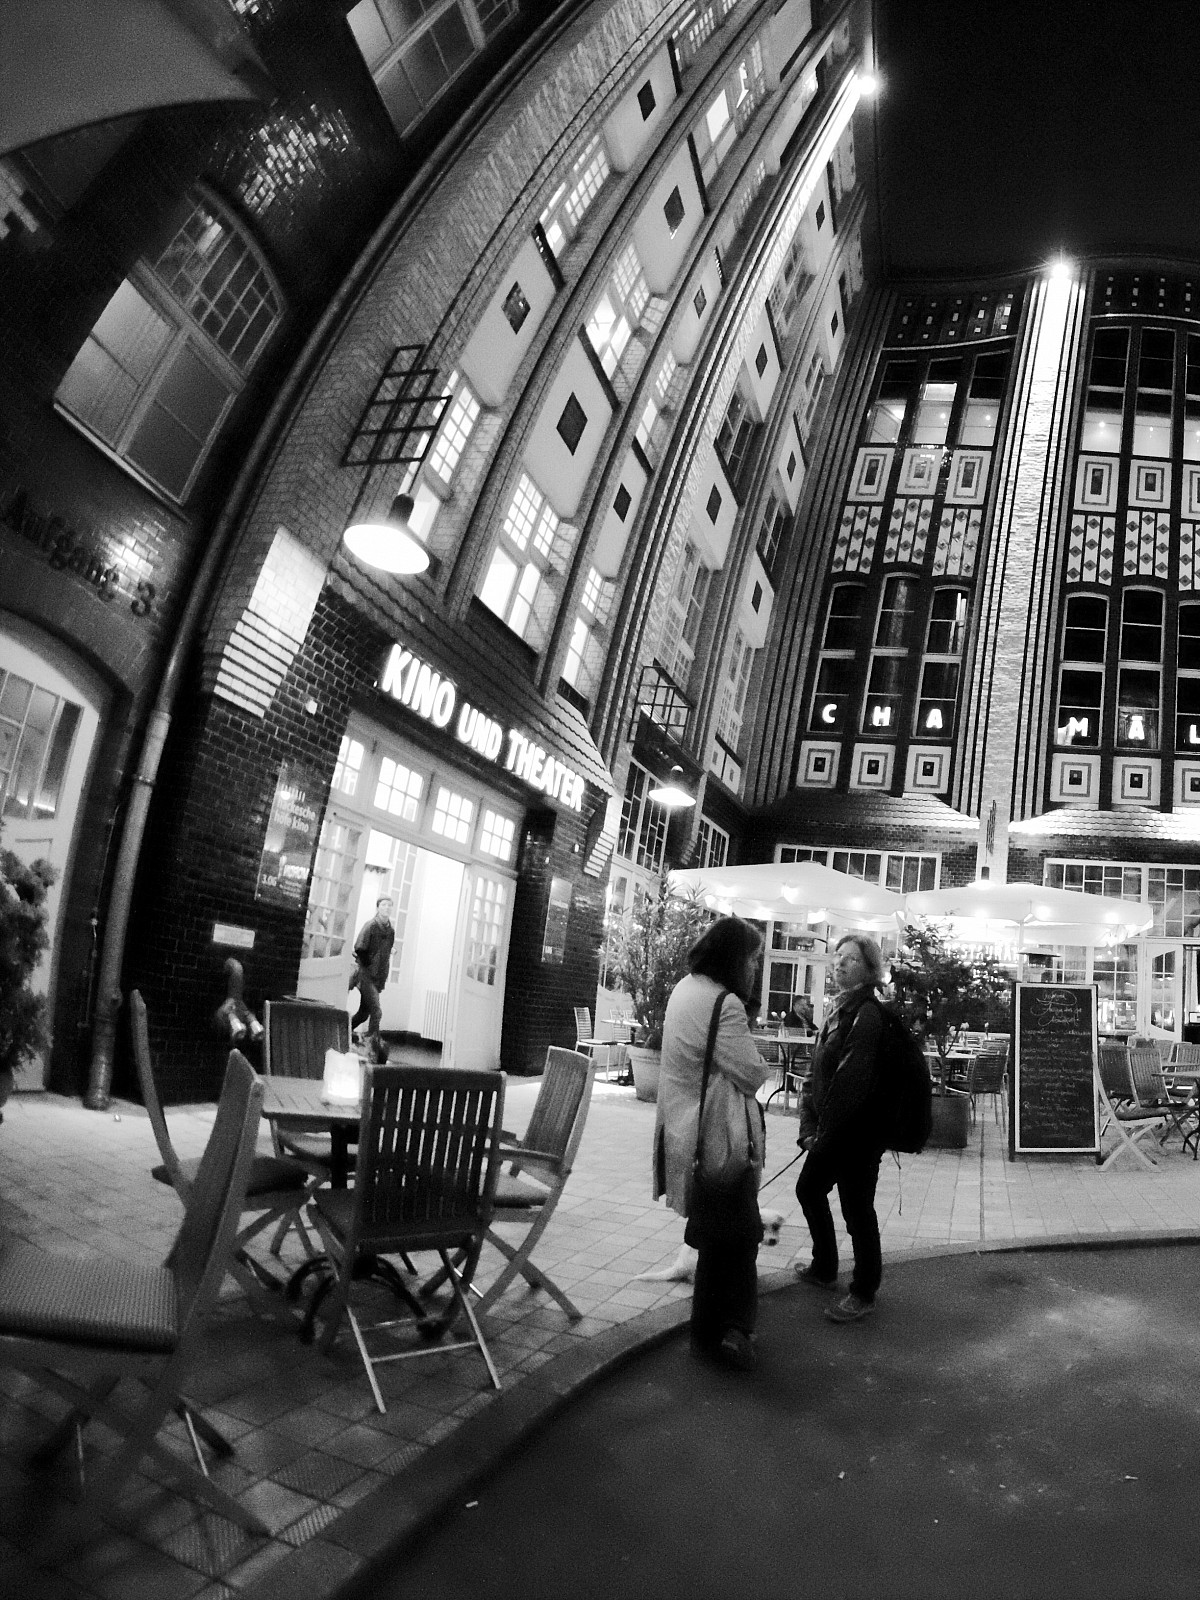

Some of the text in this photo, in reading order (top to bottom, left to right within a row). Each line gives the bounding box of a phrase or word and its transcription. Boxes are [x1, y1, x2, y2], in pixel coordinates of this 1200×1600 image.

[131, 581, 156, 617] 3
[382, 643, 585, 812] KINO UND THEATER
